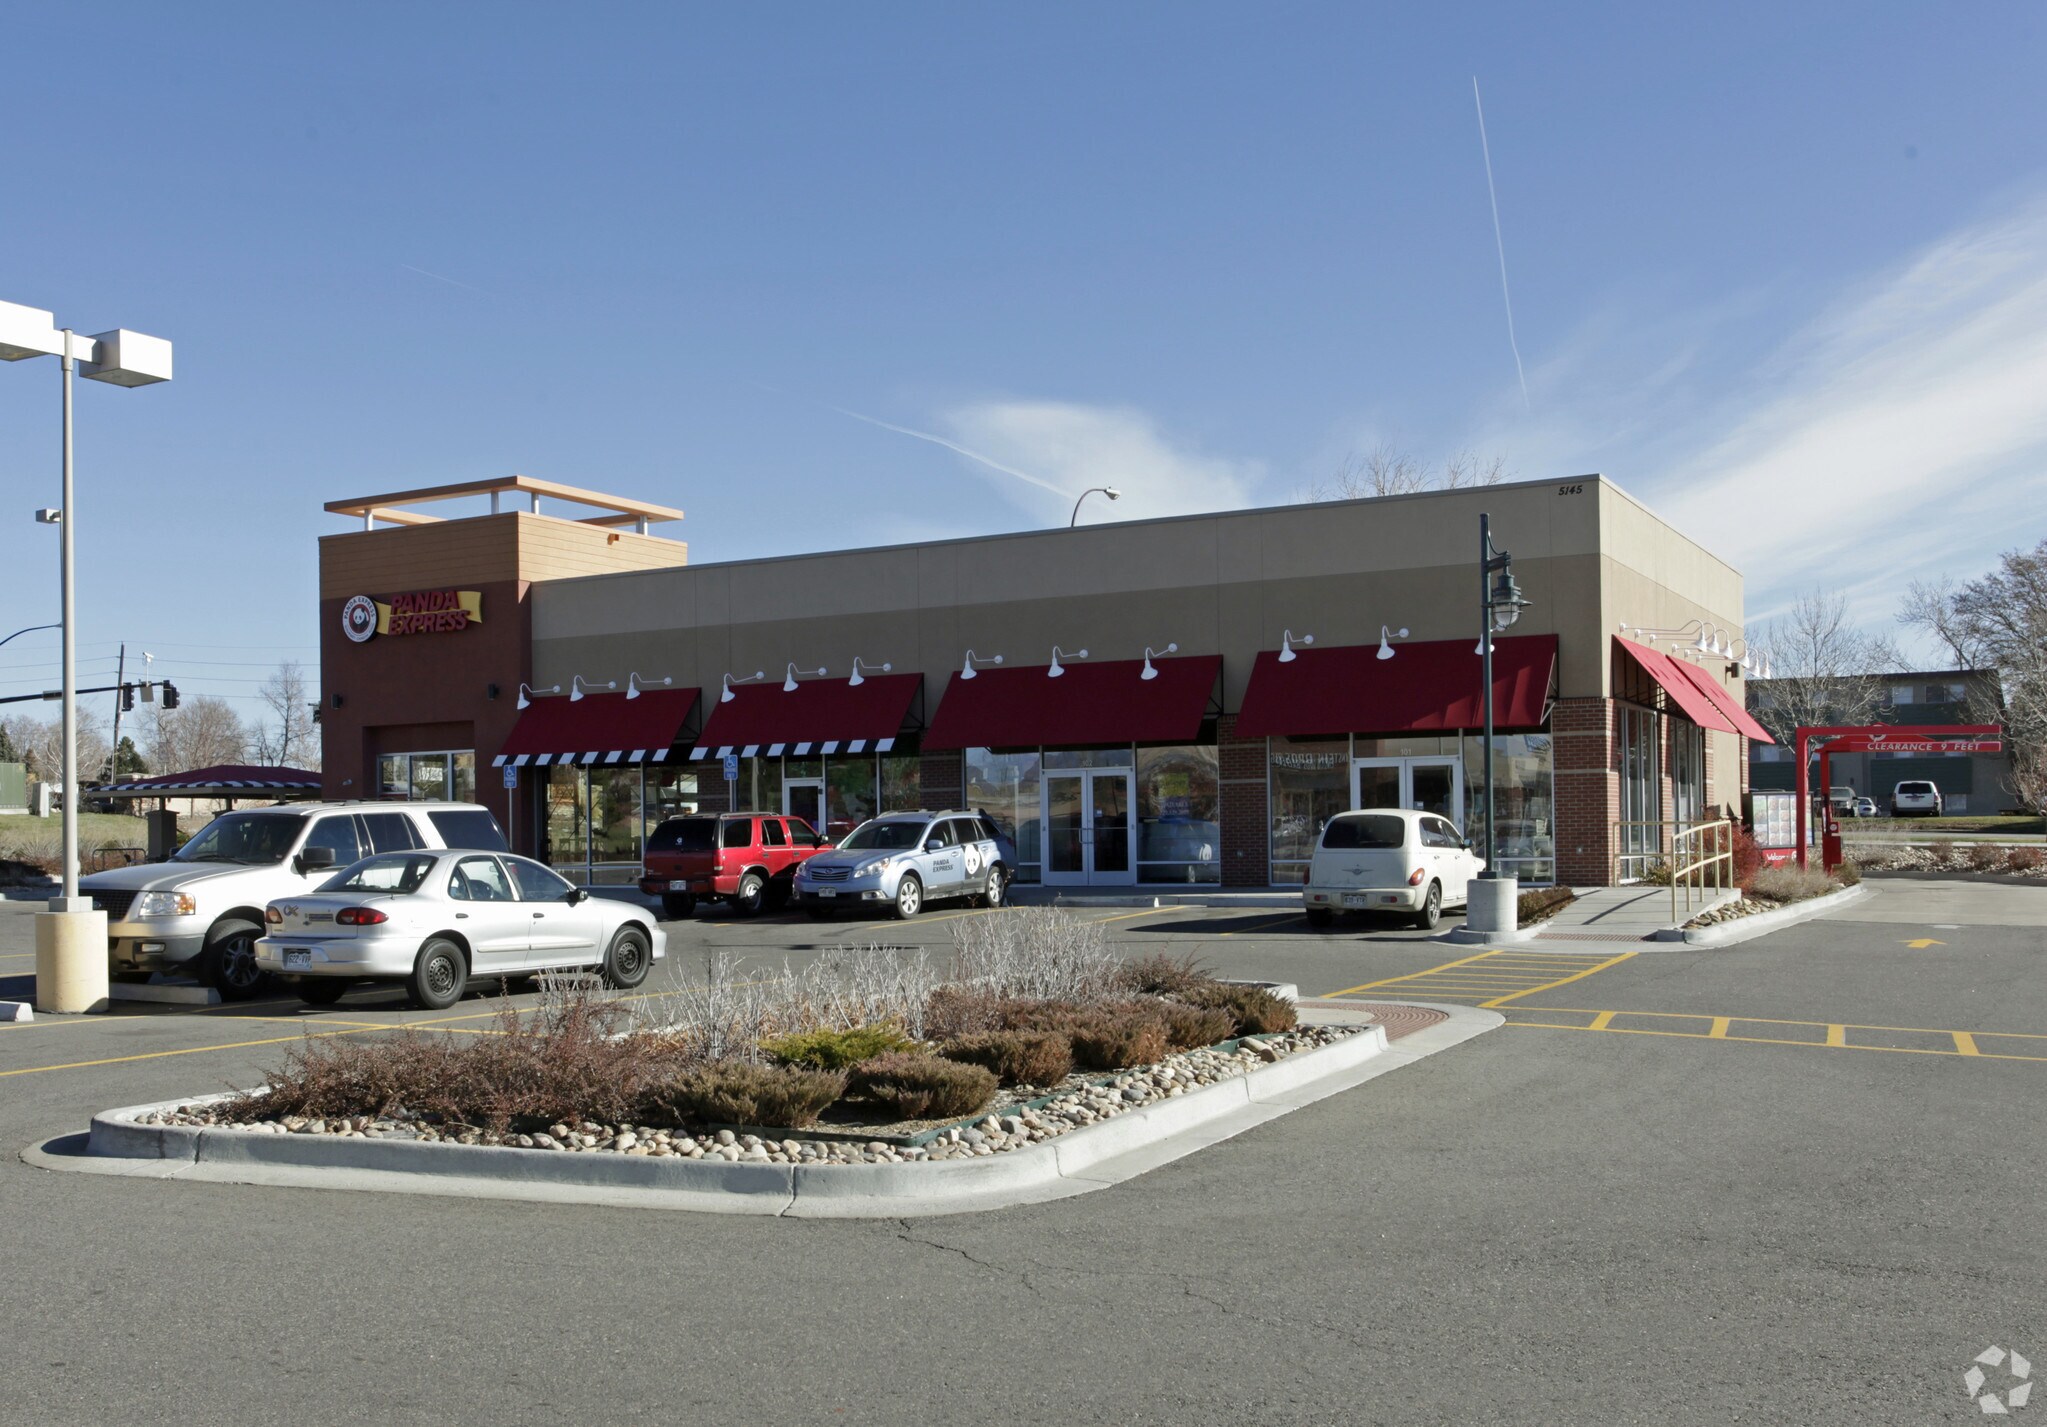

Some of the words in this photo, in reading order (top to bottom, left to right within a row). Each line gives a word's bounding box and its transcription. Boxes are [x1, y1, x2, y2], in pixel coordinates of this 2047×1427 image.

[1558, 485, 1583, 496] 5145
[344, 599, 358, 620] PANDA
[357, 597, 376, 618] EXPRESS
[391, 591, 460, 616] PANDA
[388, 610, 470, 636] EXPRESS
[1867, 743, 1932, 751] CLEARANCE
[1941, 743, 1948, 751] 9
[1954, 743, 1980, 751] FEET
[933, 864, 954, 873] EXPRESS
